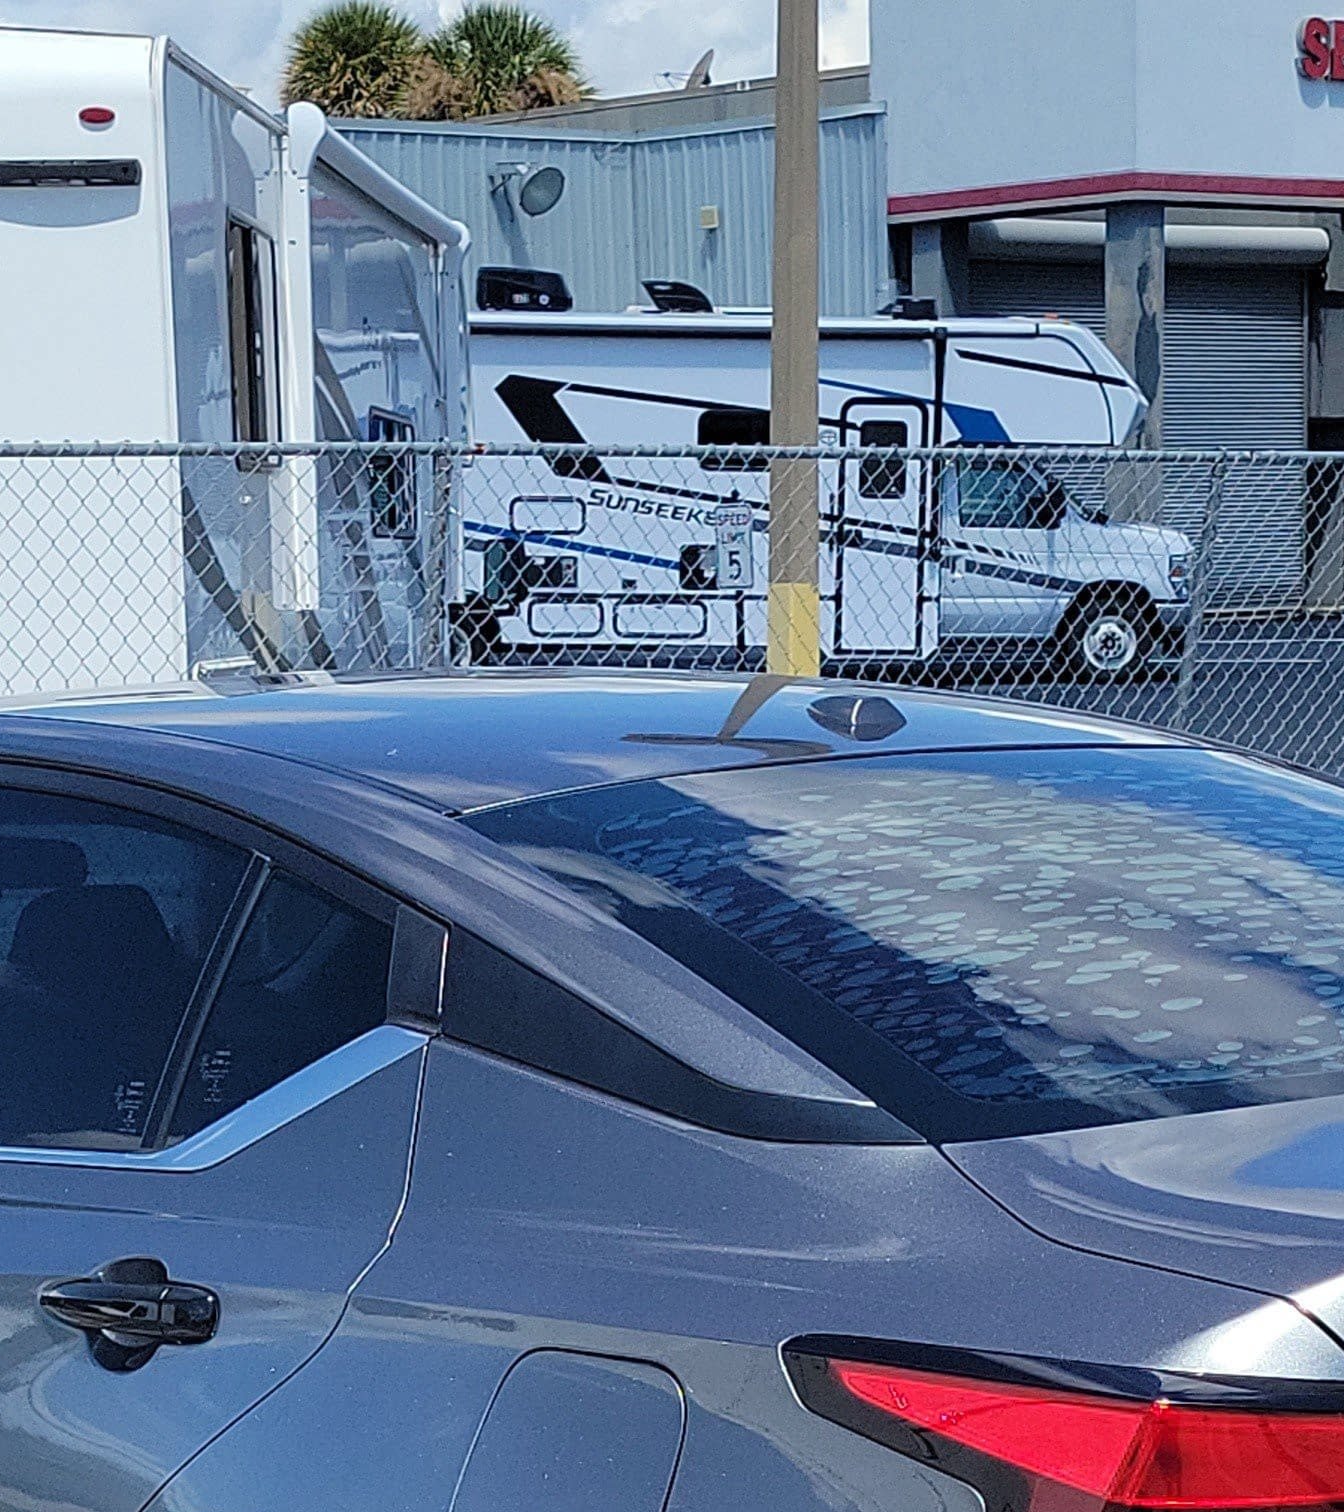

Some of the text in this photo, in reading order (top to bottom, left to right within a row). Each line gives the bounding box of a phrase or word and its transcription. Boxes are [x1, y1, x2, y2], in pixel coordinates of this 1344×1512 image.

[587, 488, 717, 527] SUNSEEKE
[717, 512, 749, 526] SPEED
[728, 550, 742, 580] 5
